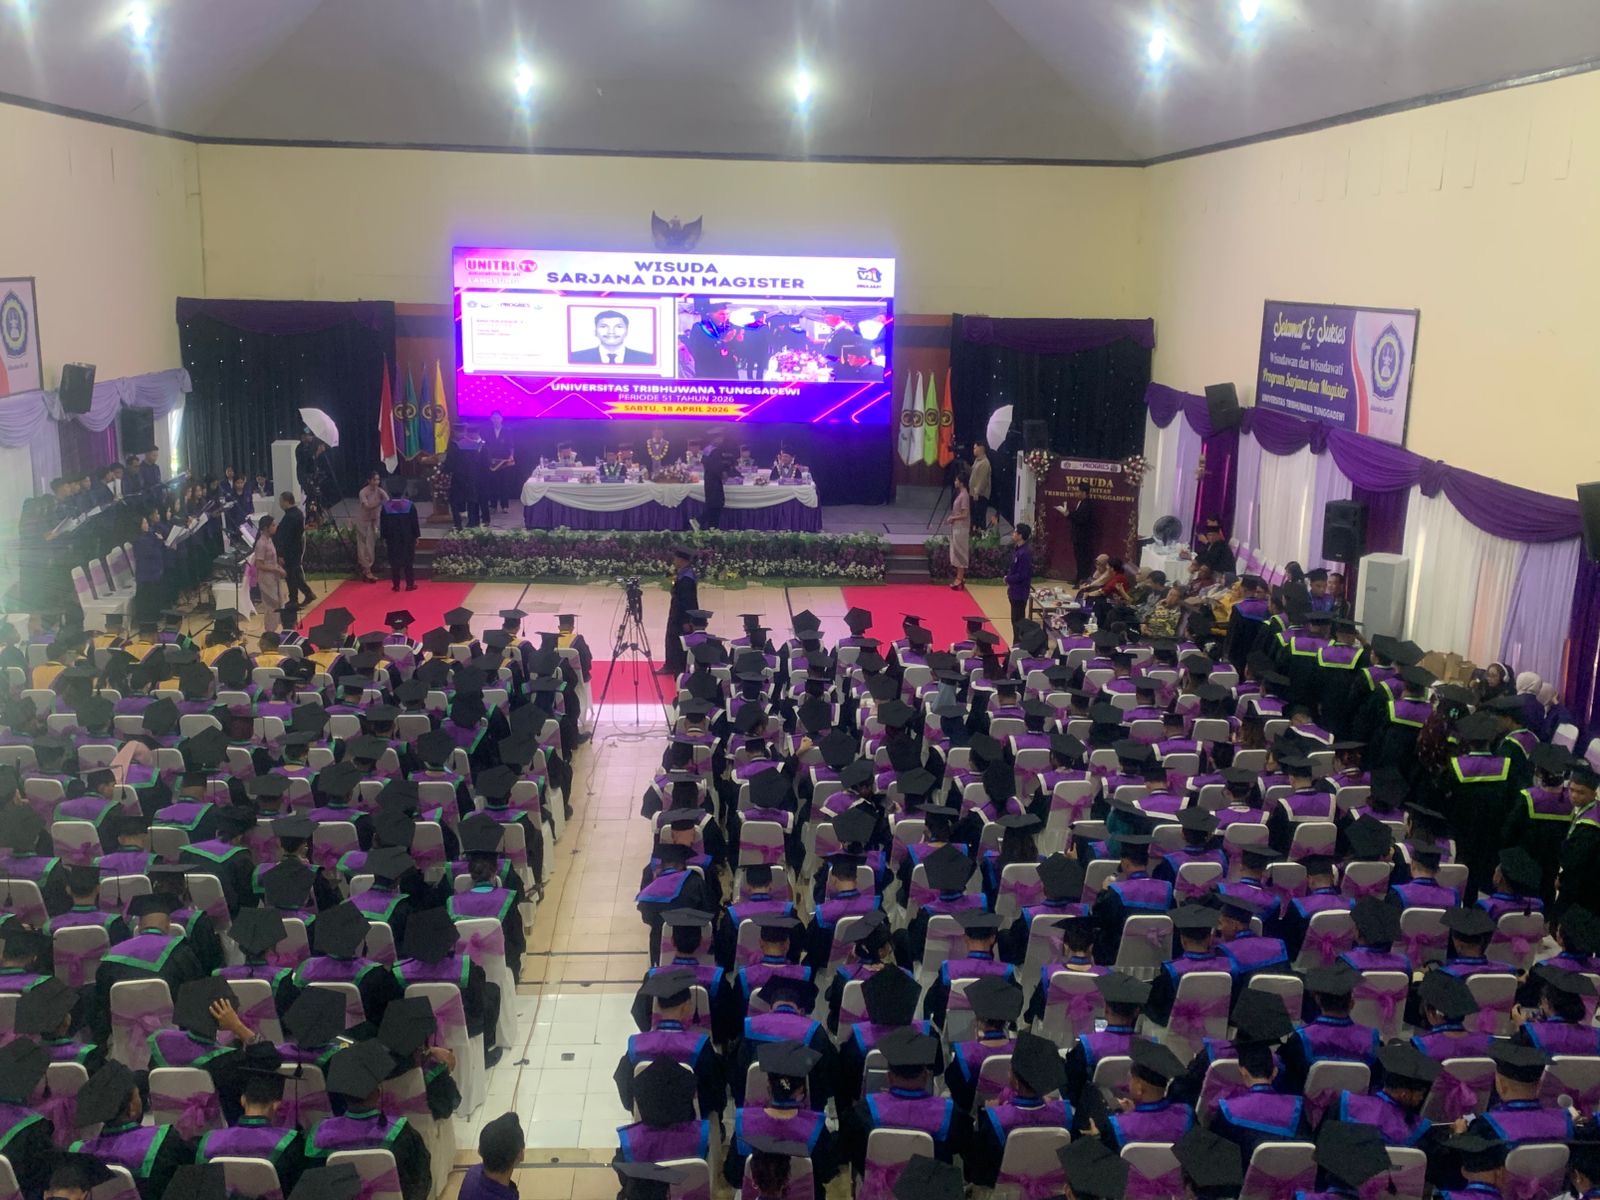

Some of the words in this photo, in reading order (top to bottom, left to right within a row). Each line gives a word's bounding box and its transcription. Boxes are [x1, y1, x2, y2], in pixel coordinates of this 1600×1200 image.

[467, 260, 515, 271] UNITRI
[520, 262, 537, 271] TV
[634, 261, 719, 274] WISUDA
[547, 272, 646, 286] SARJANA
[652, 275, 696, 287] DAN
[702, 276, 805, 289] MAGISTER
[1273, 312, 1307, 341] Selamat
[1307, 316, 1316, 340] &
[1317, 315, 1347, 347] Sukses
[1270, 352, 1298, 368] Wisudawan
[1299, 356, 1309, 370] dan
[1310, 358, 1344, 376] Wisudawati
[551, 383, 630, 393] UNIVERSITAS
[632, 385, 716, 394] TRIBHUWANA
[719, 386, 800, 396] TUNGGADEWI
[1263, 368, 1286, 388] Program
[1285, 372, 1308, 393] Sarjana
[1308, 378, 1320, 393] dan
[1320, 379, 1349, 401] Magister
[618, 393, 660, 401] PERIODE
[624, 405, 660, 413] SABTU,
[1313, 406, 1345, 421] TUNGGADEWI
[1065, 476, 1114, 488] WISUDA
